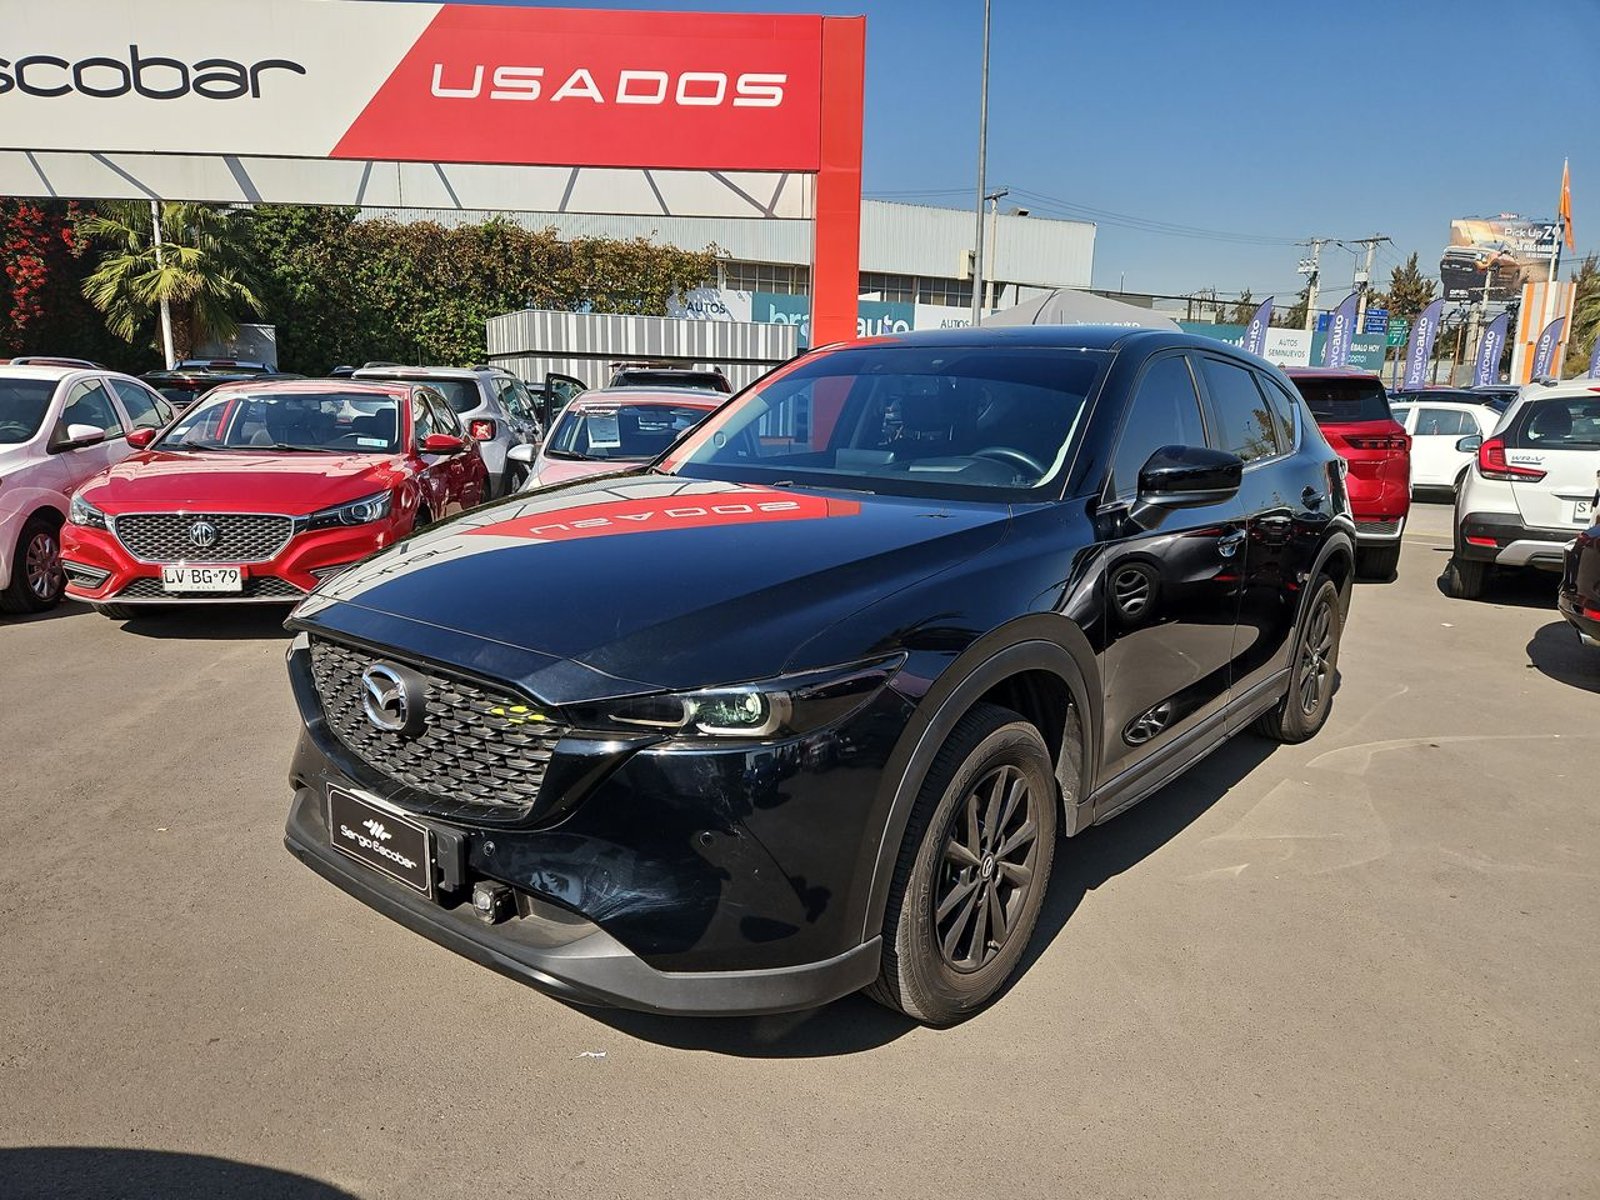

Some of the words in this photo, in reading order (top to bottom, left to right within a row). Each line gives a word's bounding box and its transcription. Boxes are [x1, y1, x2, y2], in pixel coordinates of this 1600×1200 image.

[430, 63, 788, 107] USADOS
[1504, 228, 1526, 237] Pick
[1528, 228, 1542, 240] Up
[687, 301, 726, 314] AUTOS
[940, 319, 970, 329] AUTOS
[1278, 339, 1298, 347] AUTOS
[1268, 348, 1306, 358] SEMINUEVOS
[1408, 317, 1428, 384] bravoauto
[191, 523, 214, 546] MG
